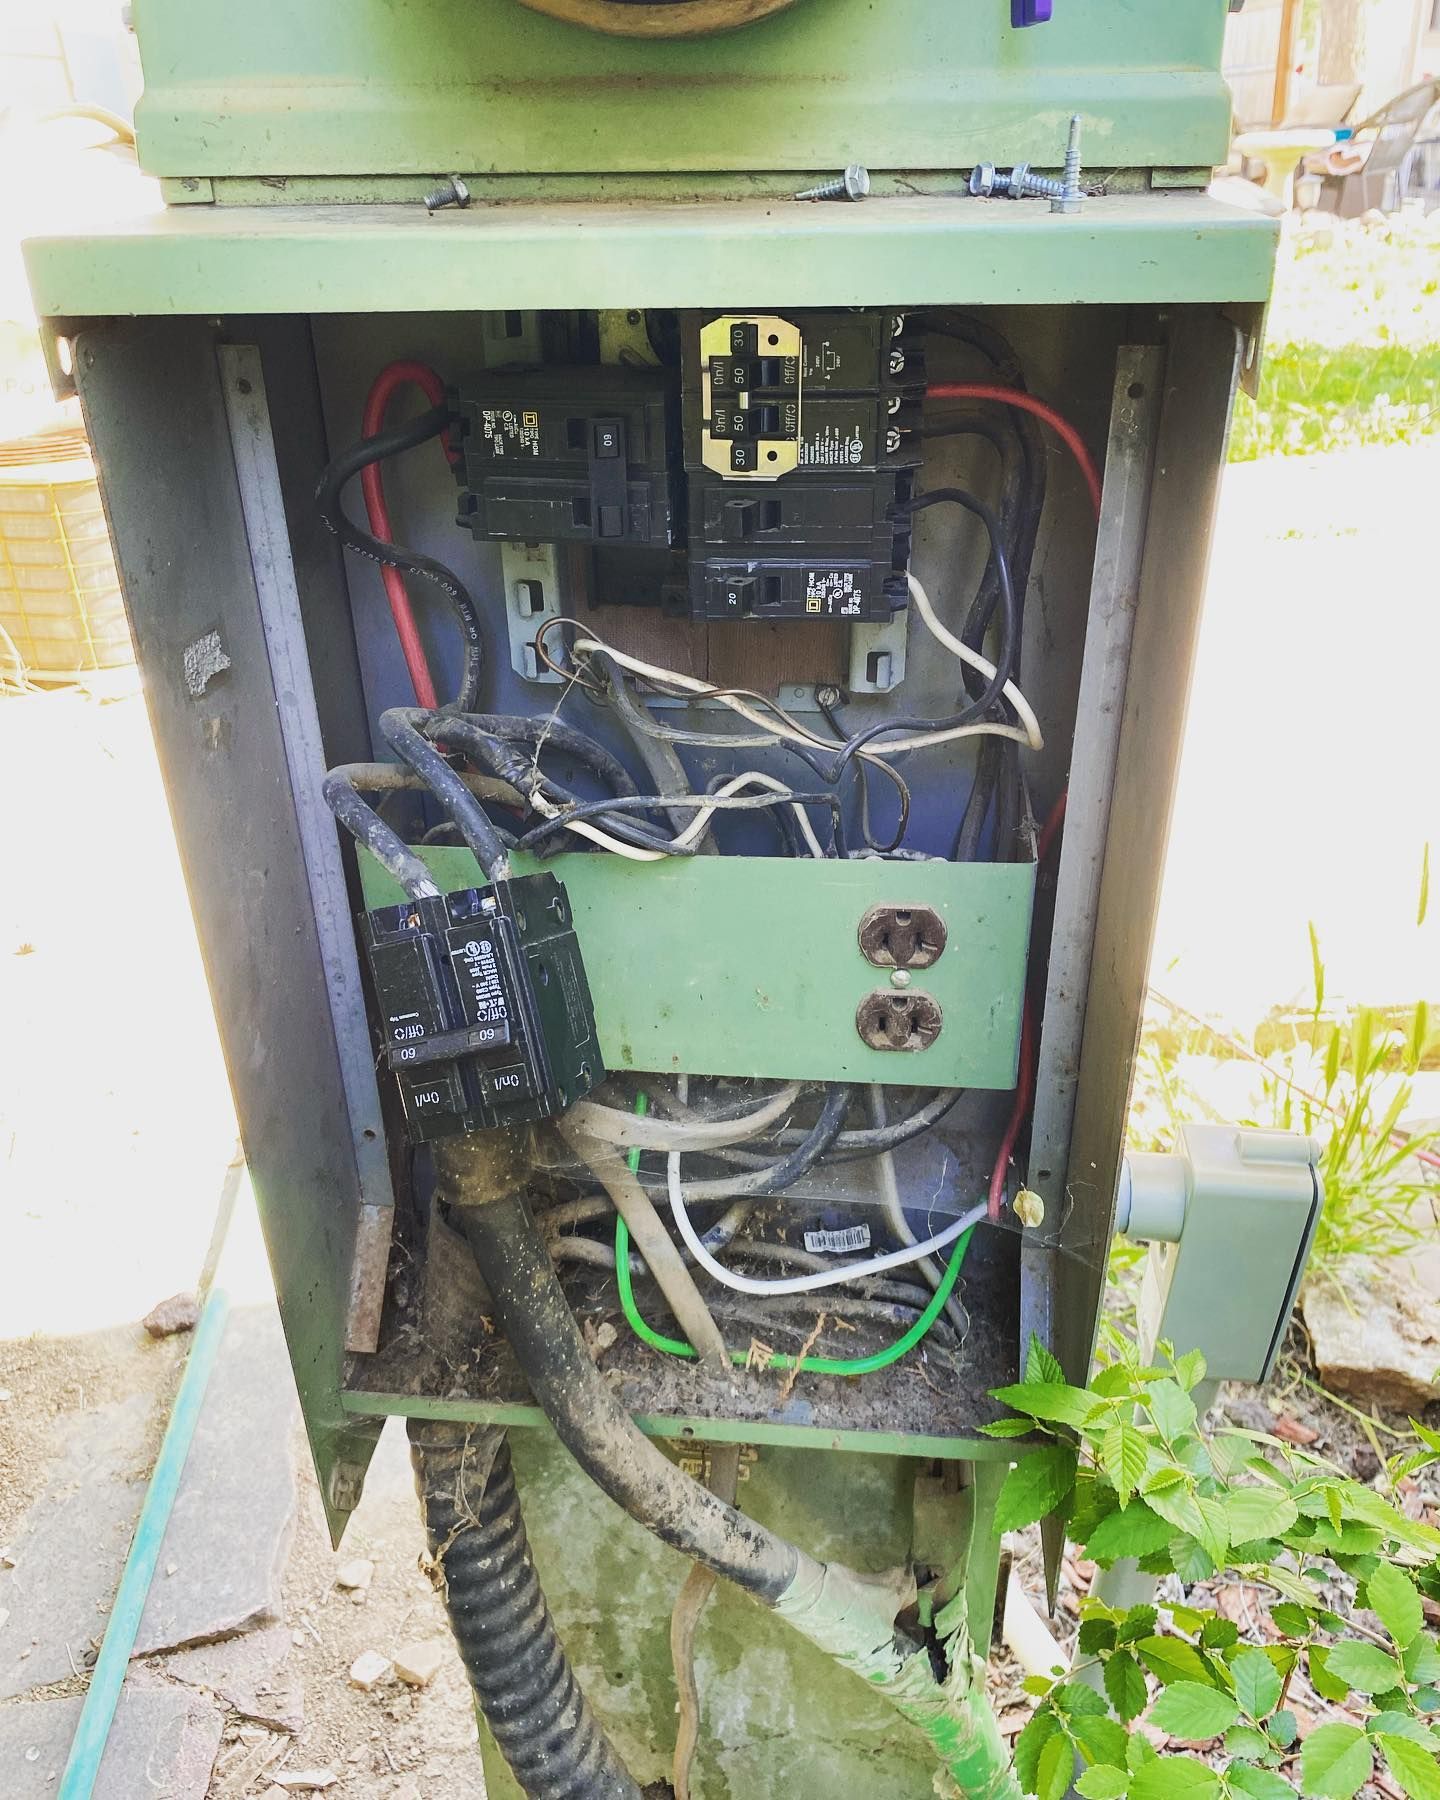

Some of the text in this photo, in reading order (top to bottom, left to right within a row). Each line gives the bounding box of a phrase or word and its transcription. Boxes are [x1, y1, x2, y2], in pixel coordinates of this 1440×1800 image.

[734, 330, 744, 347] 30
[734, 367, 744, 384] 50
[482, 410, 492, 438] DP-4075
[734, 415, 744, 432] 50
[603, 434, 612, 446] 60
[735, 449, 745, 466] 30
[440, 582, 457, 596] 600
[728, 593, 736, 605] 20
[470, 626, 478, 640] OR
[479, 1028, 495, 1041] 60
[400, 1048, 416, 1060] 60
